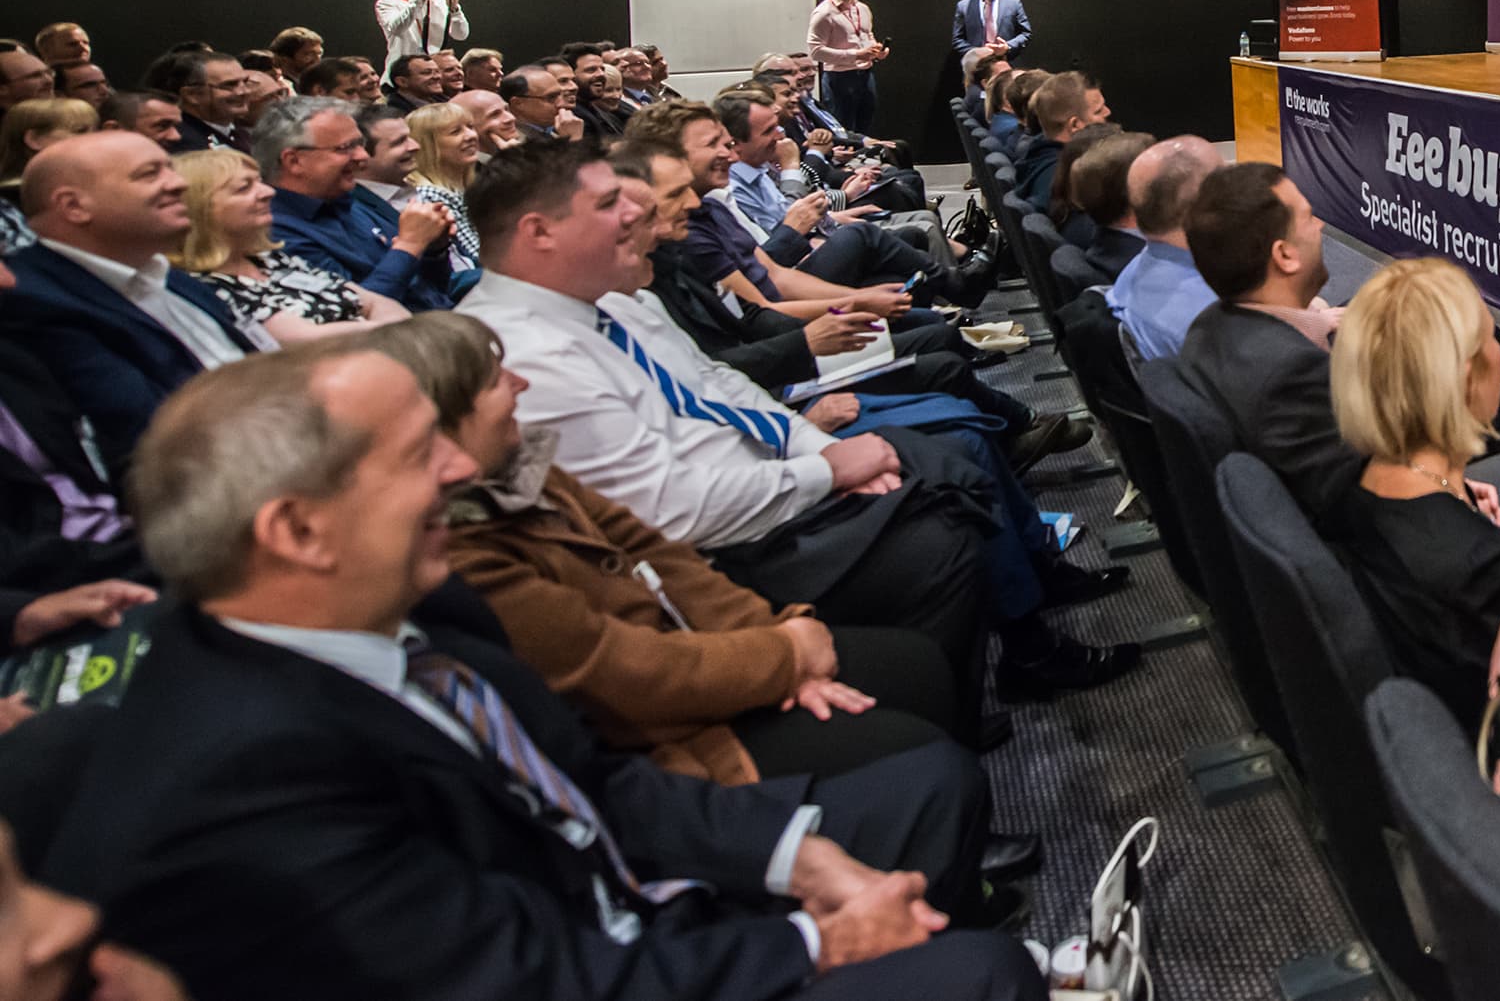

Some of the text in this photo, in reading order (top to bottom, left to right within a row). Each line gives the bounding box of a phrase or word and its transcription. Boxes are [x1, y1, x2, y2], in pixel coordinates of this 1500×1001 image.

[1293, 89, 1330, 119] the works
[1385, 112, 1443, 191] Eee
[1359, 181, 1439, 251] Specialist
